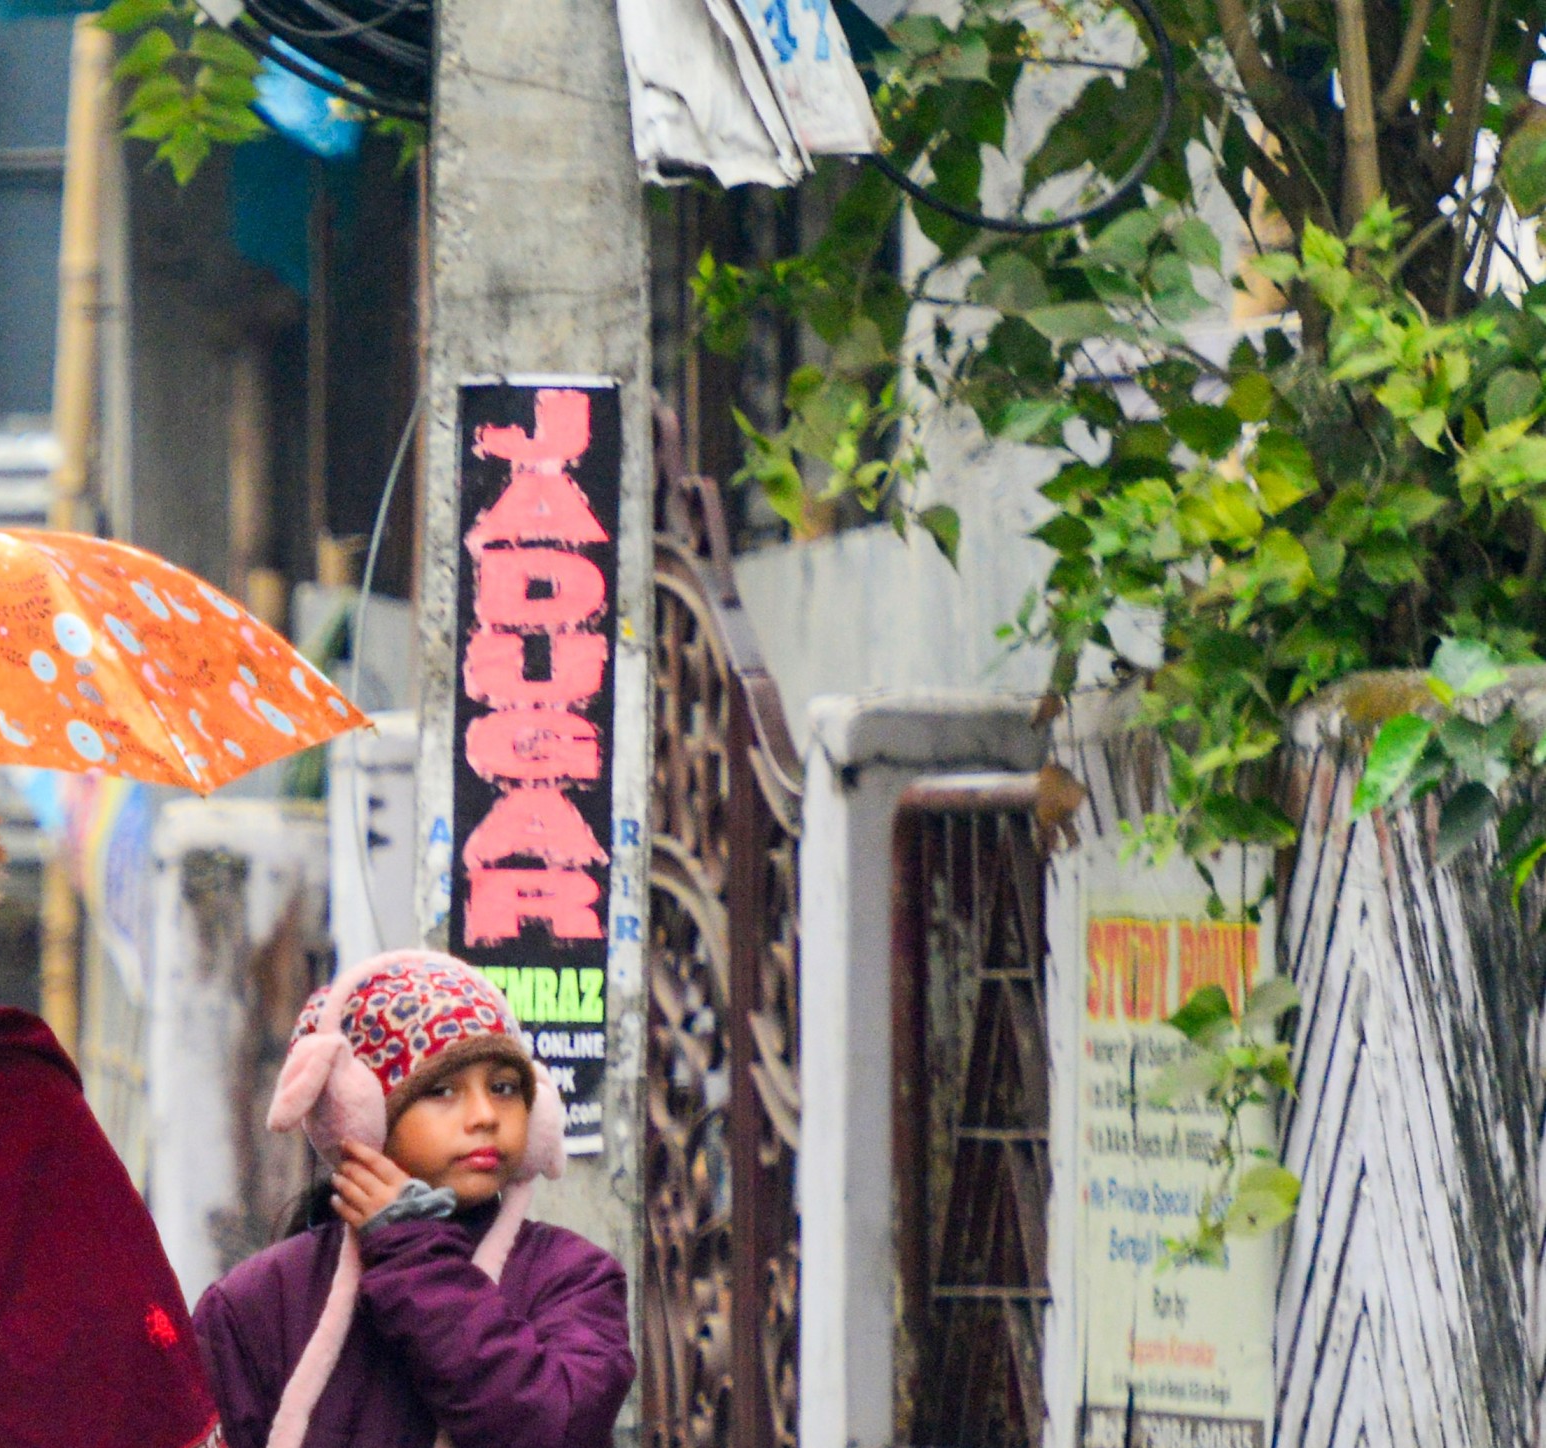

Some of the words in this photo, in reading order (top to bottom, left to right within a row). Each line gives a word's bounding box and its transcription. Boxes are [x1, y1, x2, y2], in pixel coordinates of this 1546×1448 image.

[464, 390, 609, 945] JADUGAR
[1087, 918, 1167, 1022] STUDY
[537, 1031, 605, 1058] ONLINE
